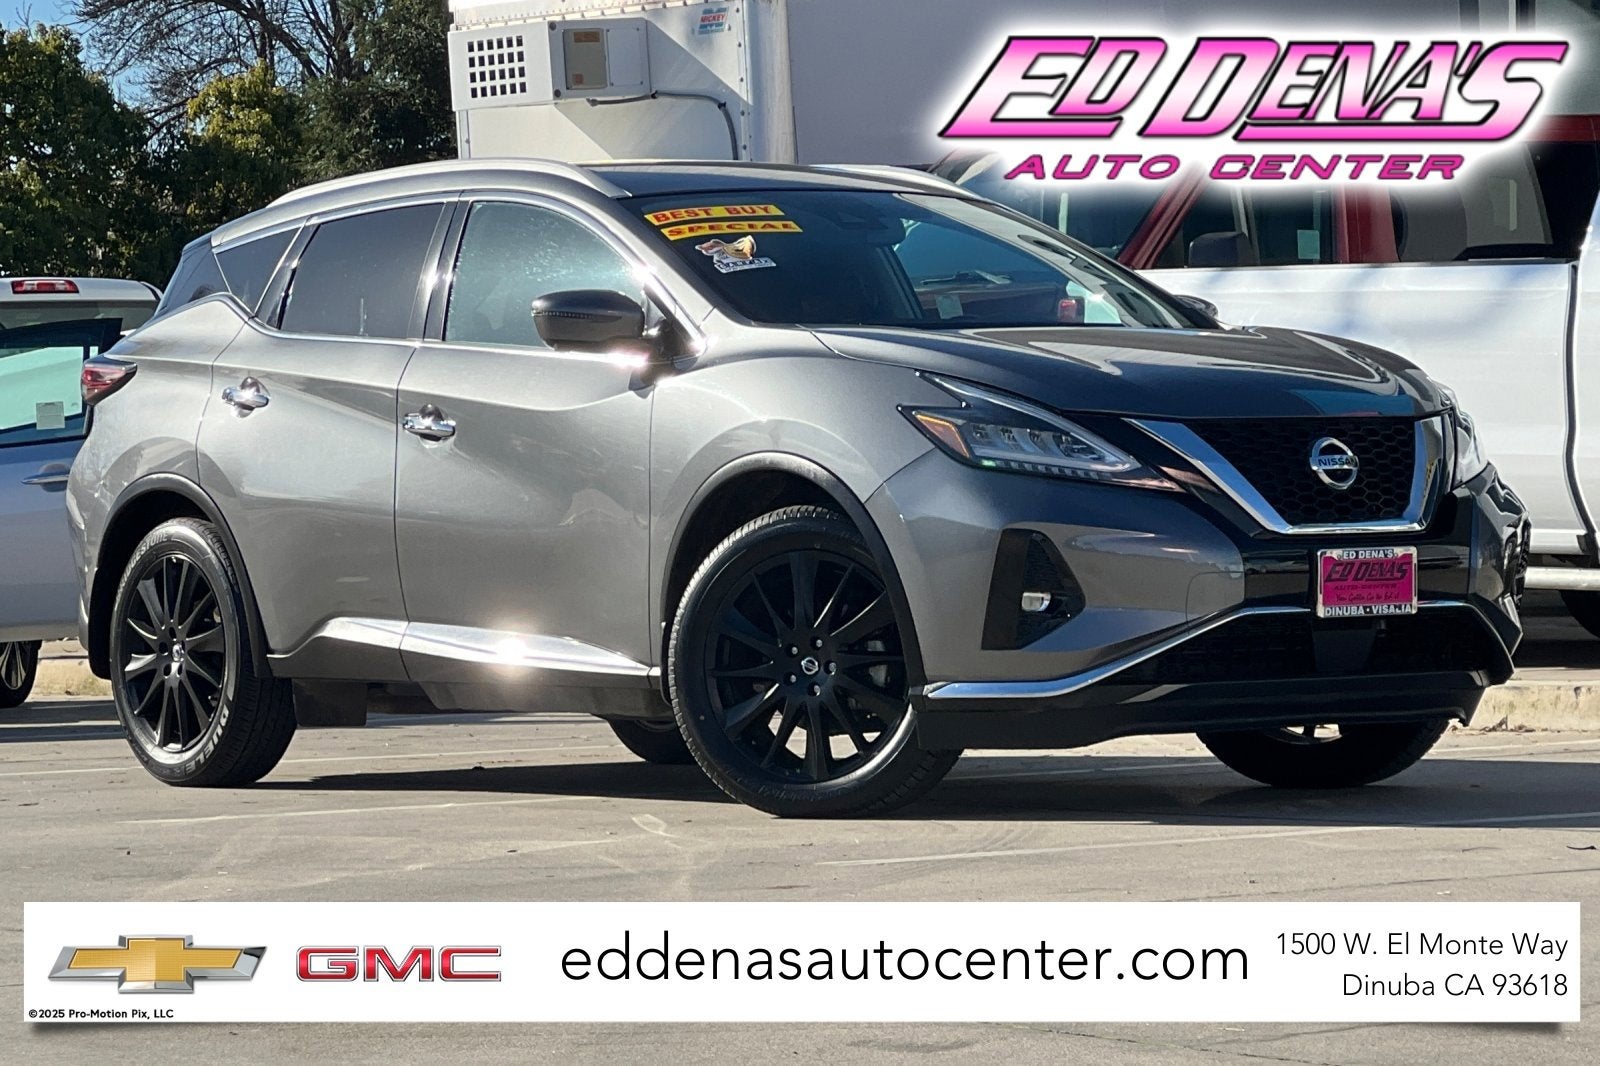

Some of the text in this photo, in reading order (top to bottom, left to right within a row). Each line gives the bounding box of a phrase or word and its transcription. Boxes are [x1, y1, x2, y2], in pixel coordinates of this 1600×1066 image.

[653, 205, 771, 223] BEST BUY
[667, 222, 798, 237] SPECIAL
[1343, 549, 1394, 559] ED DENA'S
[1325, 562, 1356, 582] ED
[1325, 604, 1412, 616] DINUBA VISALIA
